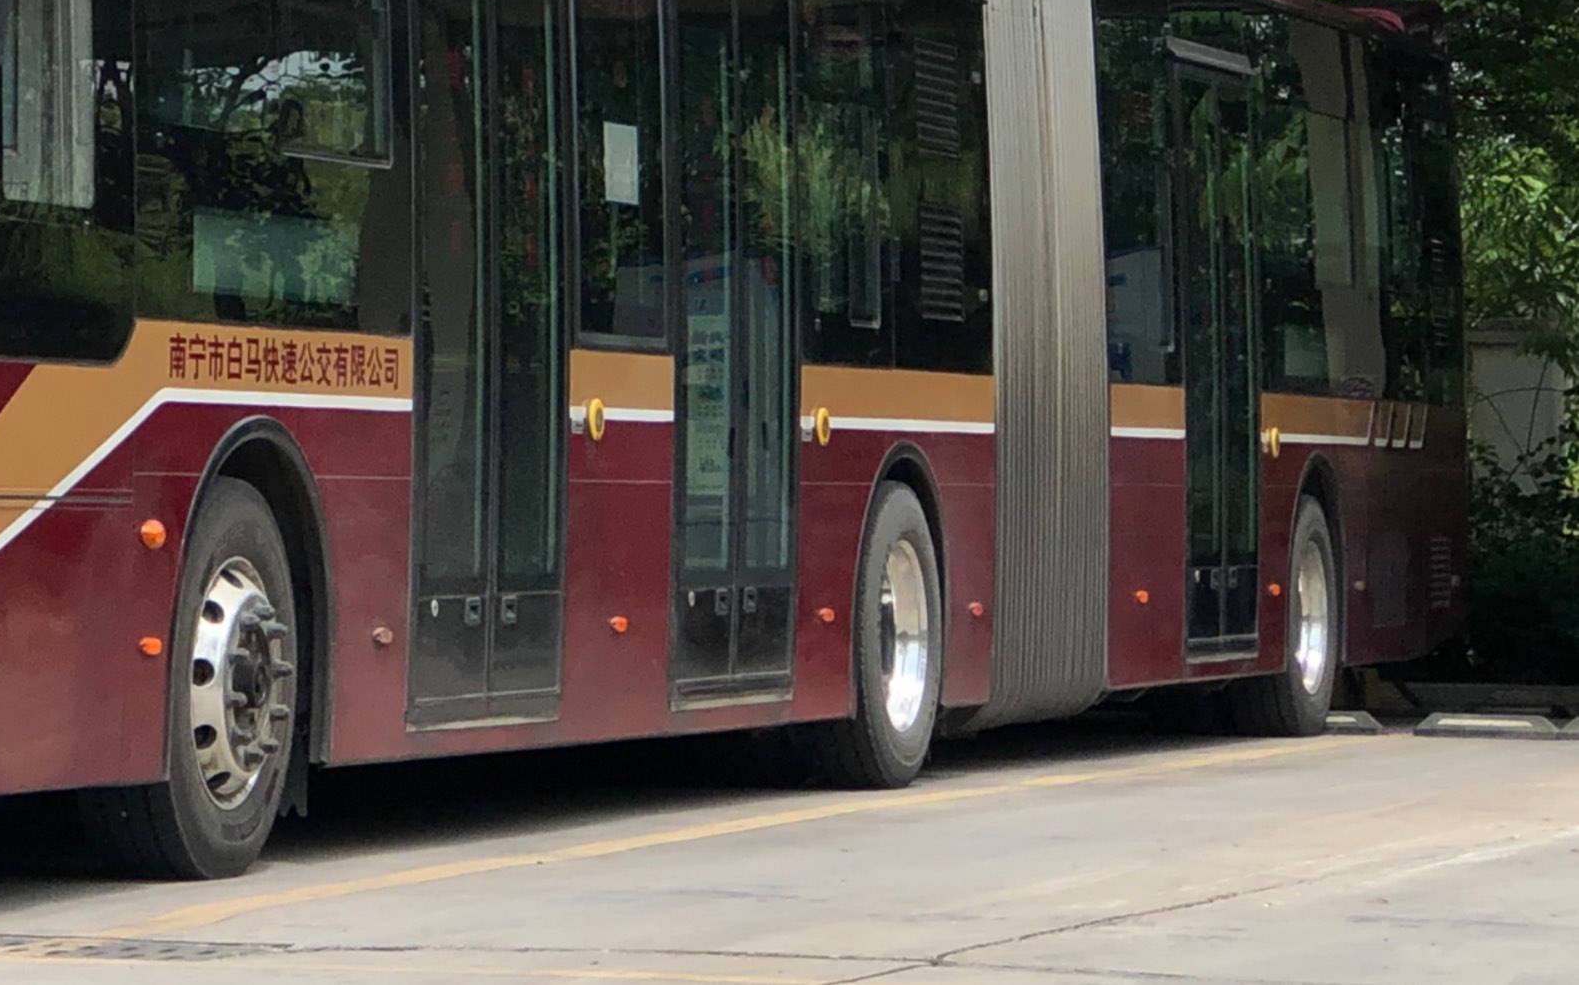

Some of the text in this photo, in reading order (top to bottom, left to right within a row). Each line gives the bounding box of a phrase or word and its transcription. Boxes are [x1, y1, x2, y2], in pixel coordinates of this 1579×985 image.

[169, 333, 399, 390] 南宁市白马快速公交有限公司
